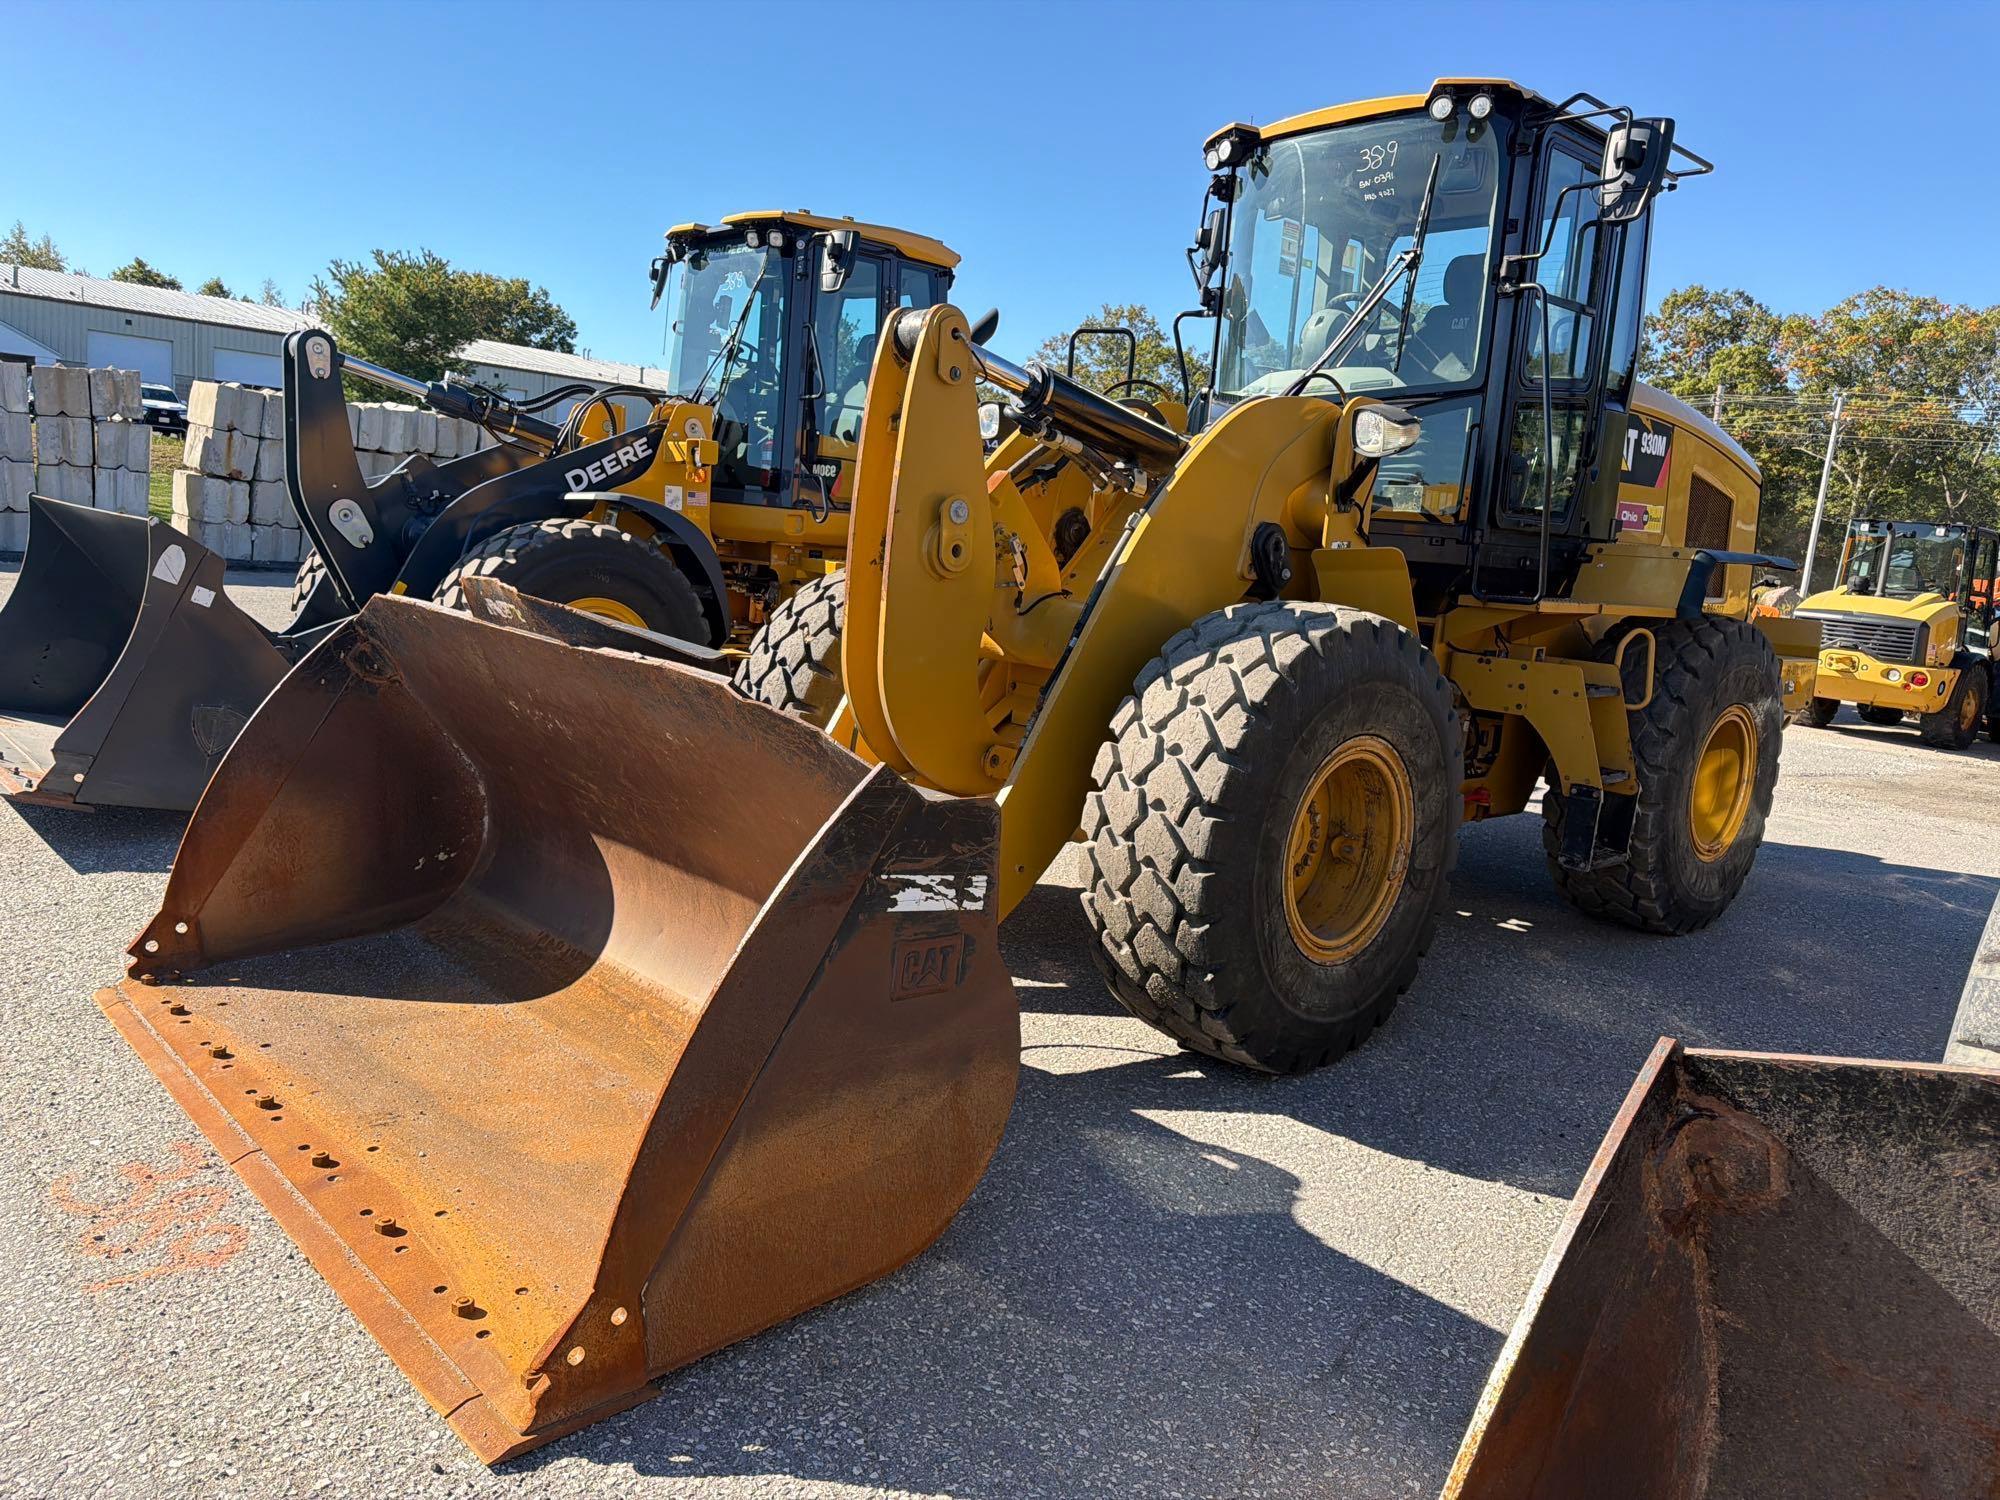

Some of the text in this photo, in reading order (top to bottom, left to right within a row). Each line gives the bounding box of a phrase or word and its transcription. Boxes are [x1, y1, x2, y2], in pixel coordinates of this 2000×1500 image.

[1356, 140, 1398, 172] 389
[721, 270, 743, 291] 388
[1451, 317, 1470, 330] CAT
[1640, 432, 1667, 457] 930M
[564, 436, 653, 493] DEERE
[1621, 510, 1638, 522] Ohio
[902, 943, 955, 991] CAT
